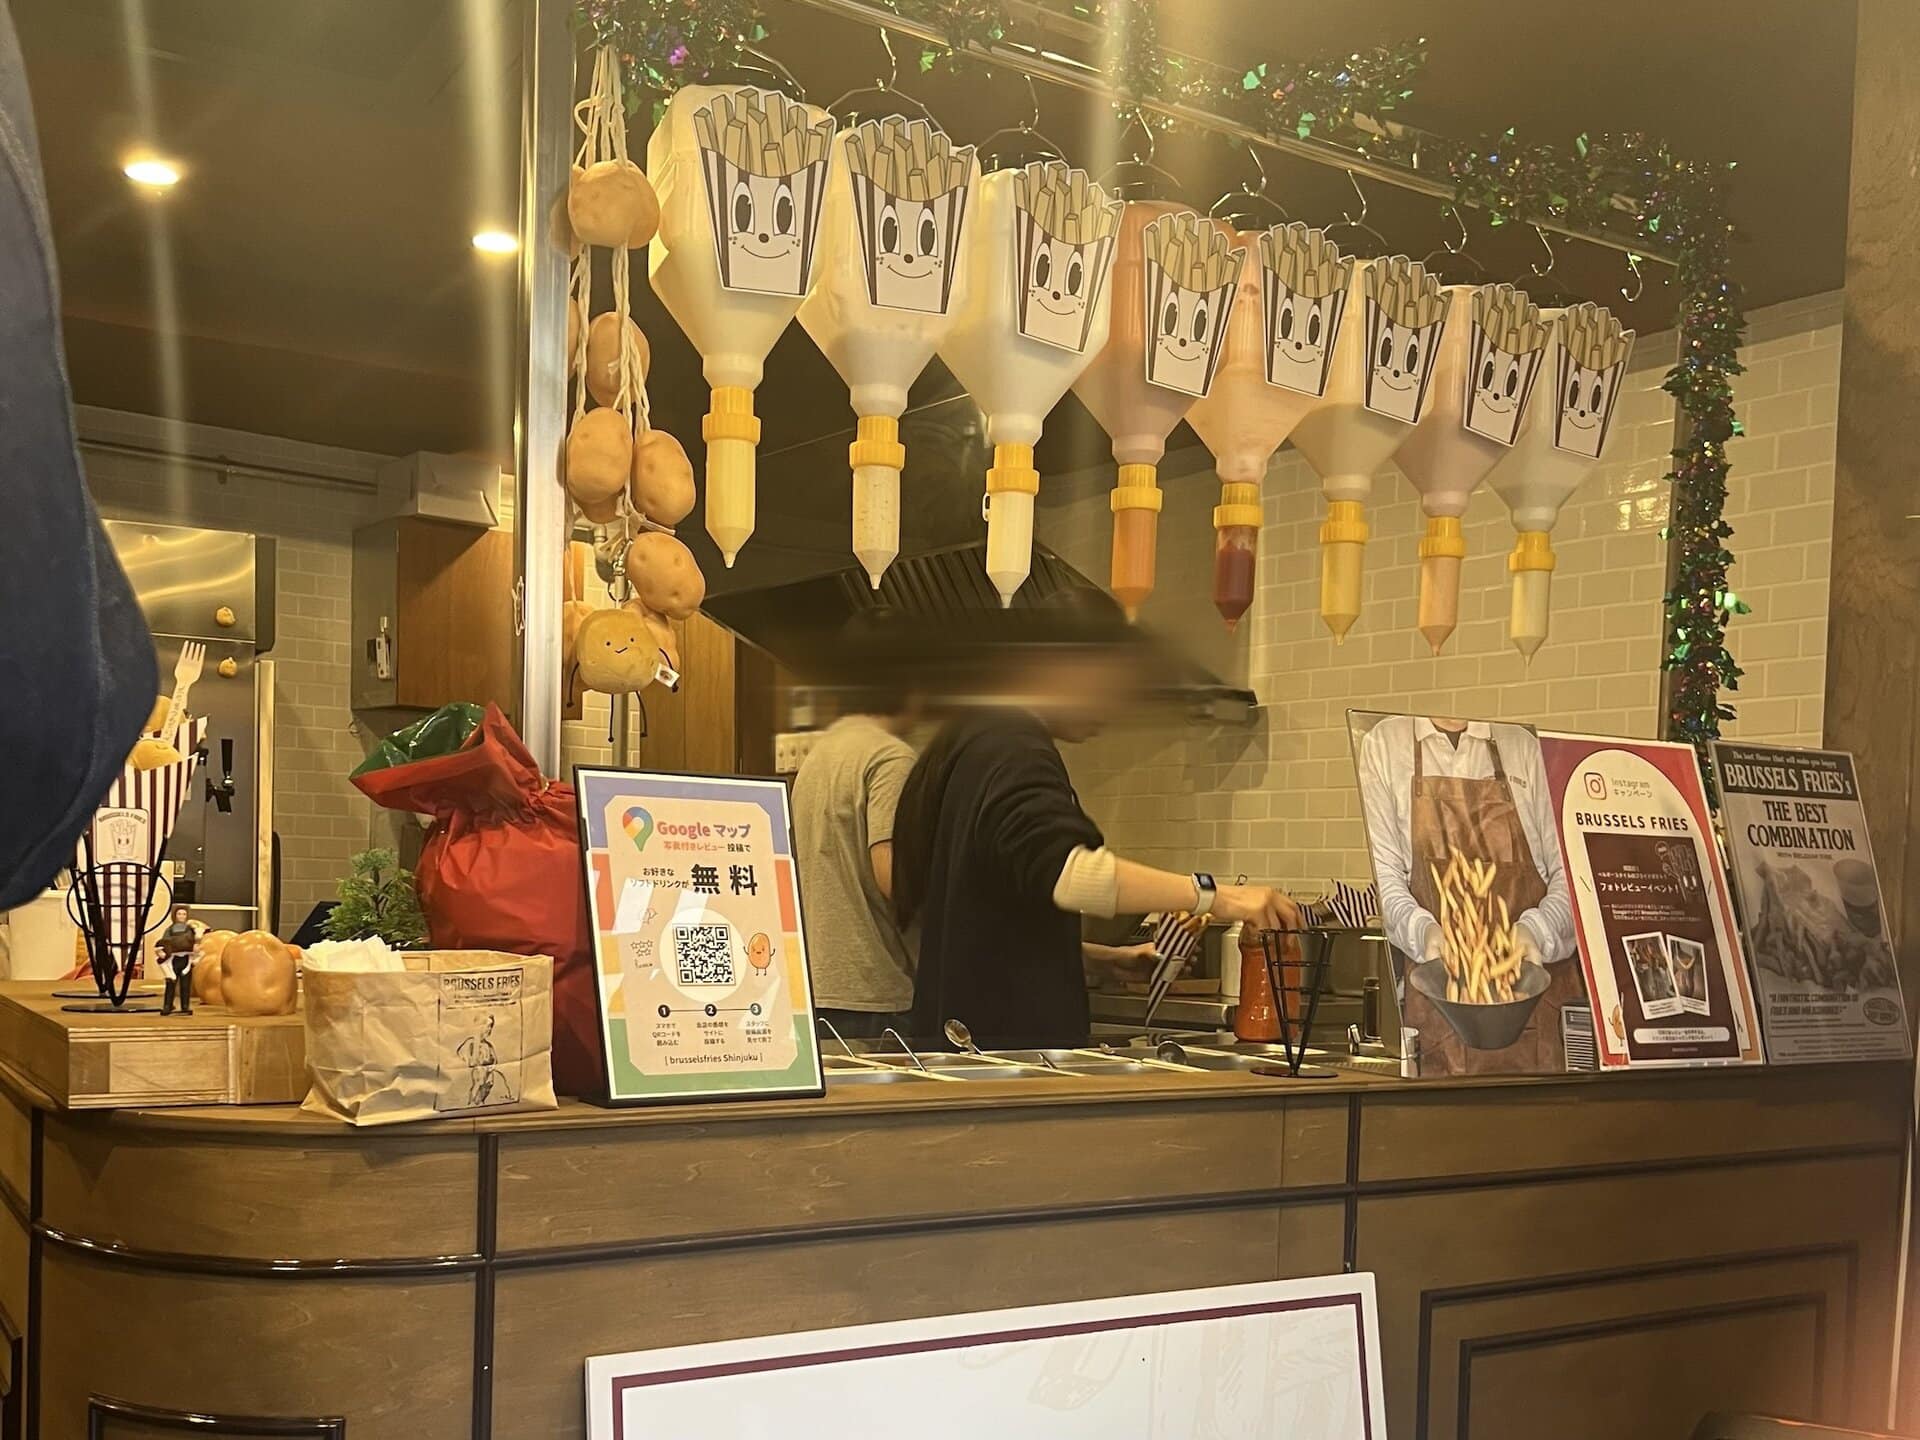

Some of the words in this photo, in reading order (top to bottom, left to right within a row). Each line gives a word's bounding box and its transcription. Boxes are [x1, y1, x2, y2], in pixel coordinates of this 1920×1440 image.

[1611, 778, 1650, 789] Instagram
[1724, 763, 1799, 791] BRUSSELS
[1614, 789, 1653, 798] キャンペーン
[1762, 800, 1792, 822] THE
[1793, 802, 1828, 824] BEST
[1576, 812, 1646, 829] BRUSSELS
[1650, 816, 1689, 831] FRIES
[656, 821, 711, 840] Google
[713, 823, 751, 838] マップ
[1747, 823, 1856, 851] COMBINATION
[643, 867, 675, 877] お好きな
[630, 879, 690, 889] ソフトドリンクが
[670, 1054, 722, 1064] brusselsfries
[723, 1053, 759, 1063] Shinjuku
